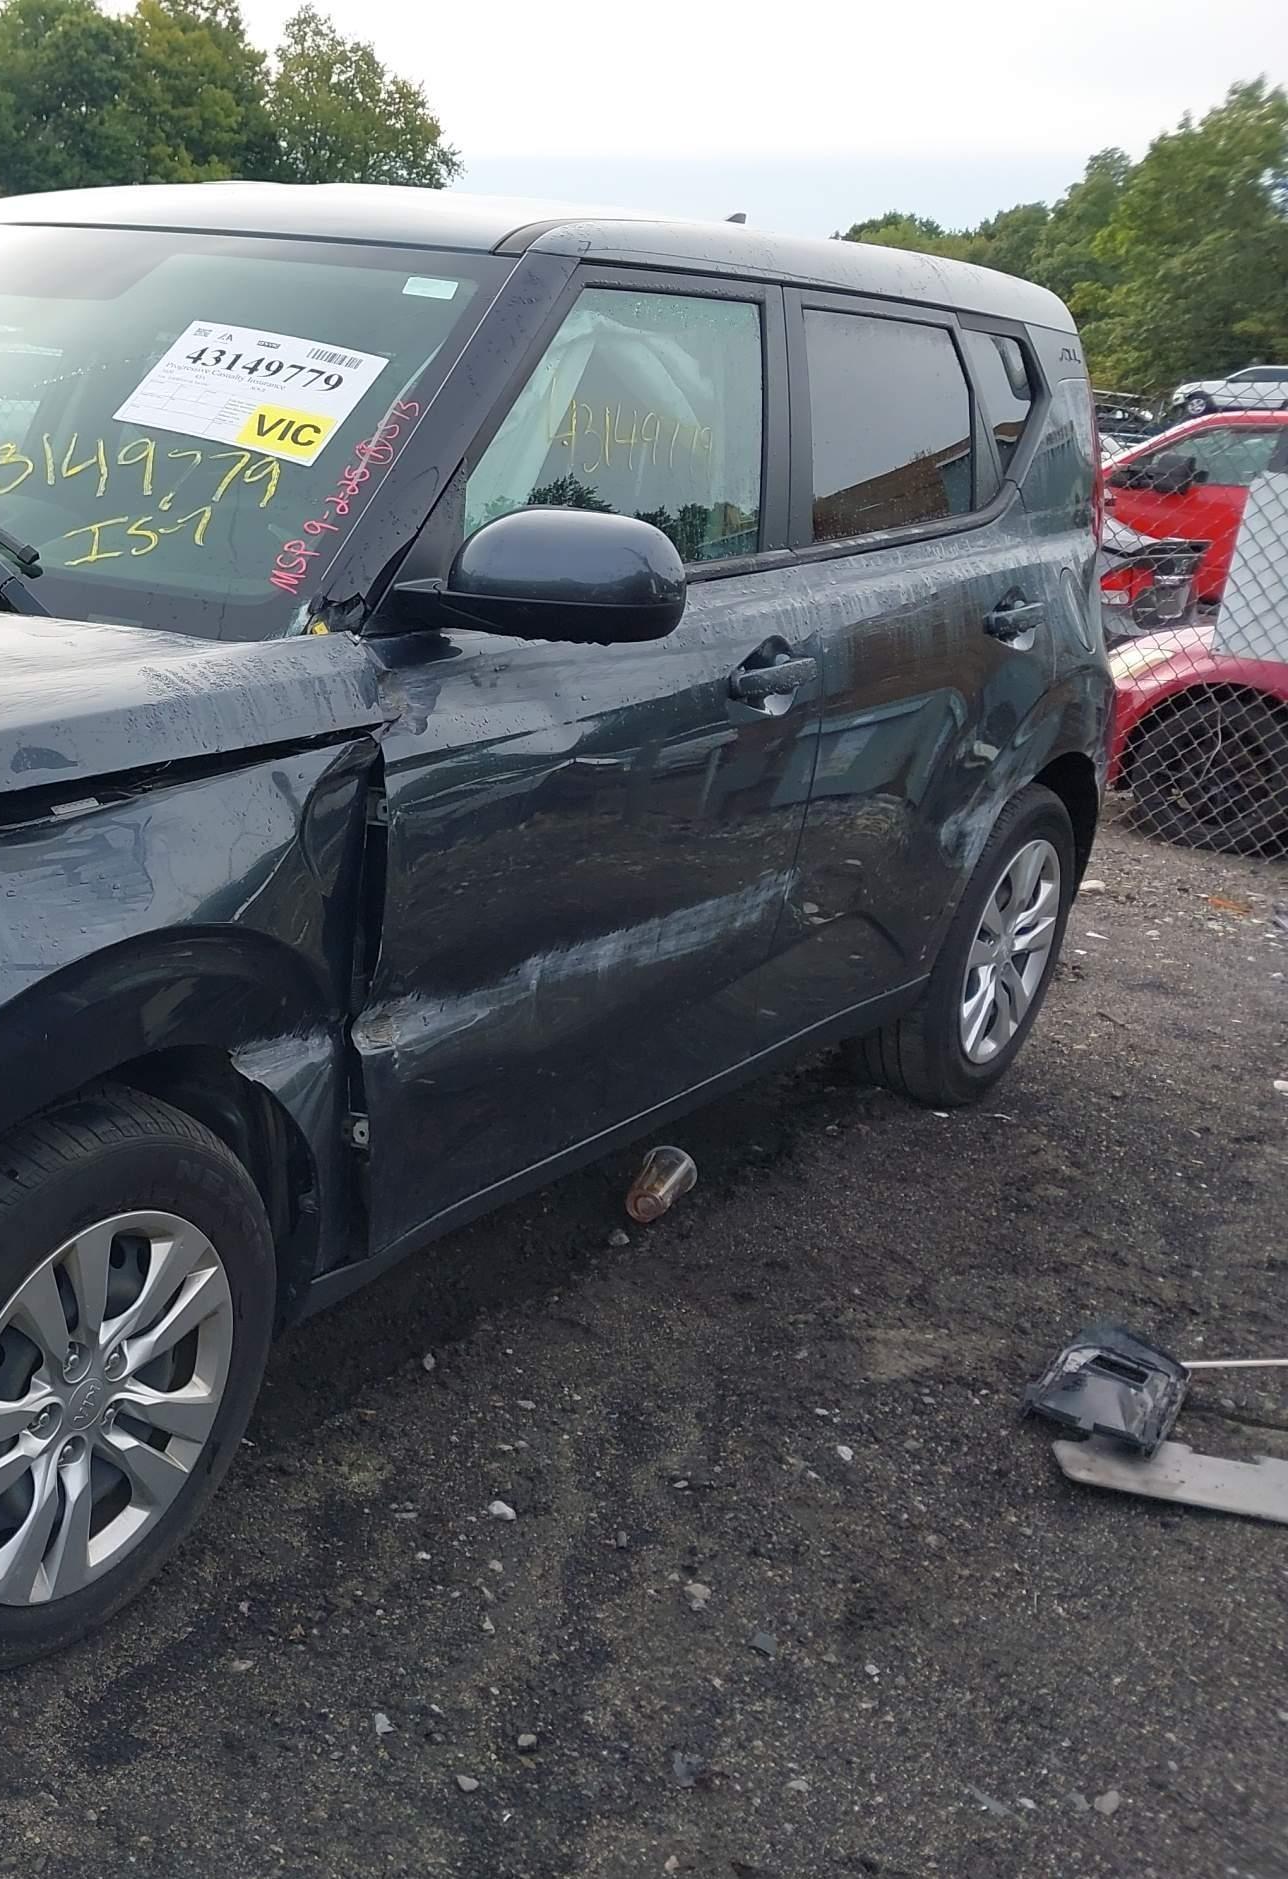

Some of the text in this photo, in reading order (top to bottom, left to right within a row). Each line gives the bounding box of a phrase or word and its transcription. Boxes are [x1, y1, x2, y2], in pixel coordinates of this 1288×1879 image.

[185, 346, 344, 392] 43149779
[212, 369, 244, 382] Casualty
[248, 376, 286, 391] Insurance
[257, 413, 322, 446] VIC
[269, 540, 321, 595] MSP
